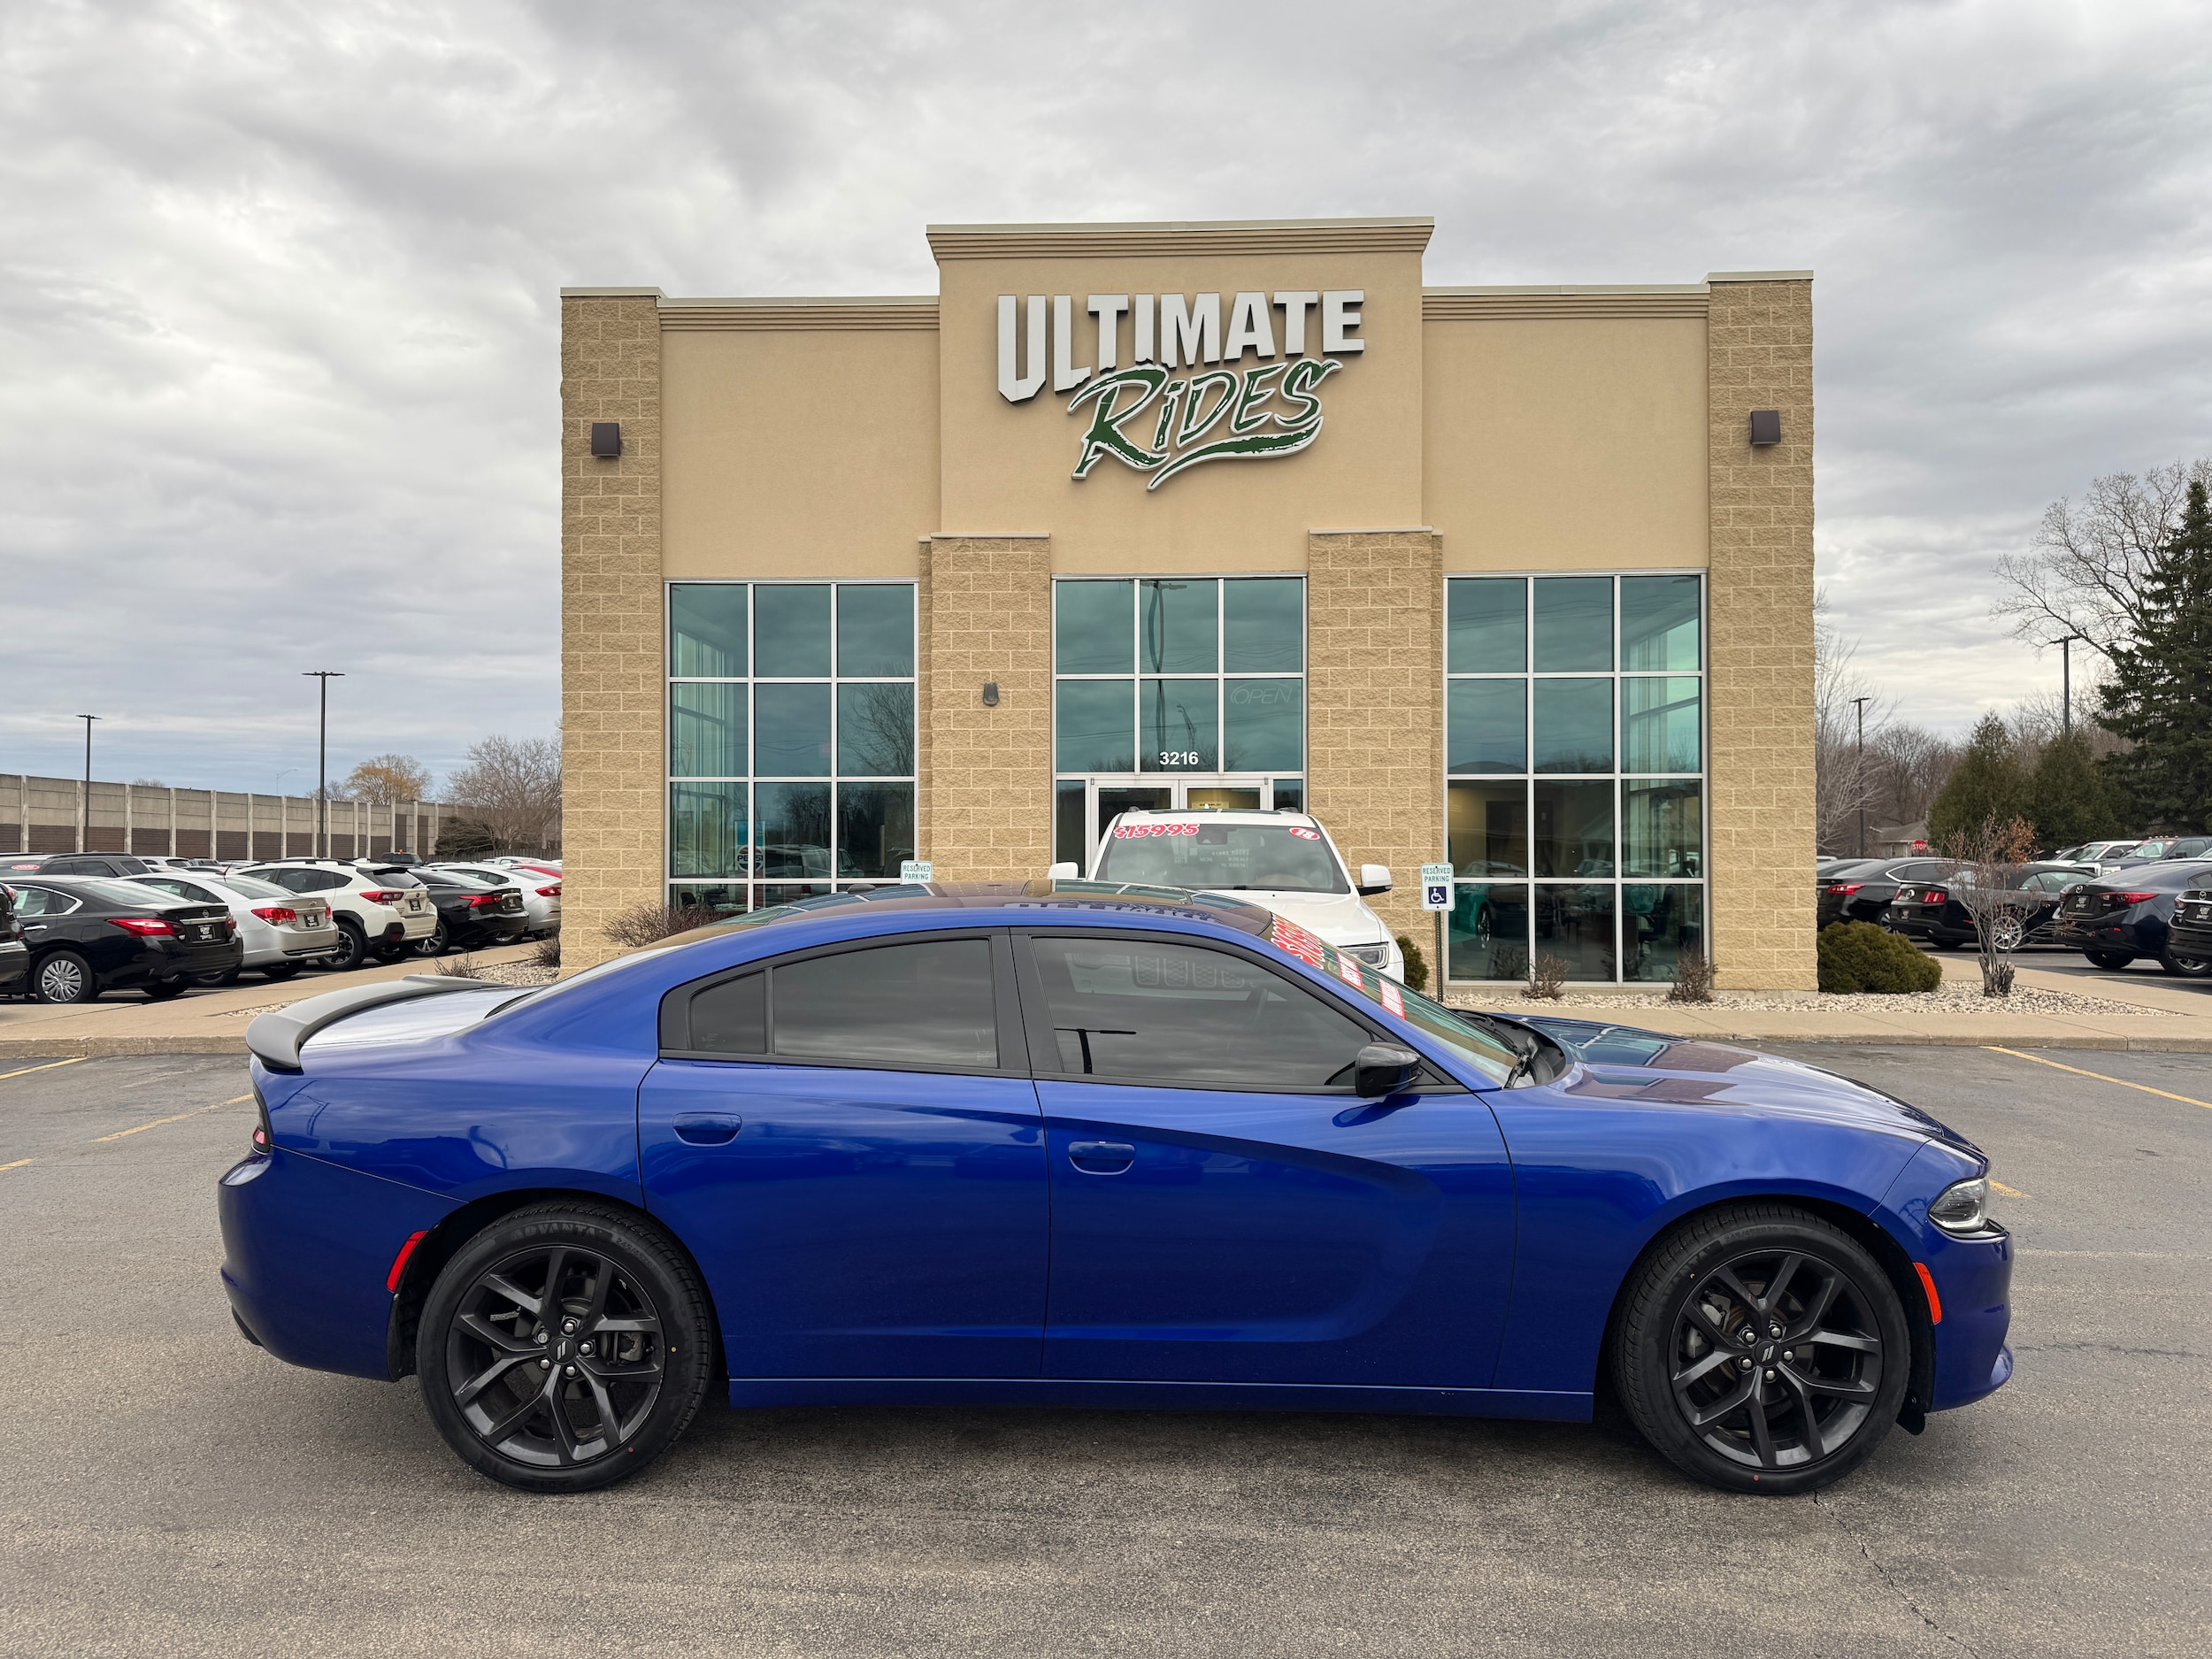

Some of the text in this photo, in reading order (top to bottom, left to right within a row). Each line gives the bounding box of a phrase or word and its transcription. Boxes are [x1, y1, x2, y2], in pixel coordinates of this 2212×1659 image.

[998, 290, 1364, 403] ULTIMATE
[1233, 687, 1292, 704] OPEN
[1159, 751, 1199, 765] 3216
[1113, 824, 1200, 839] $15995
